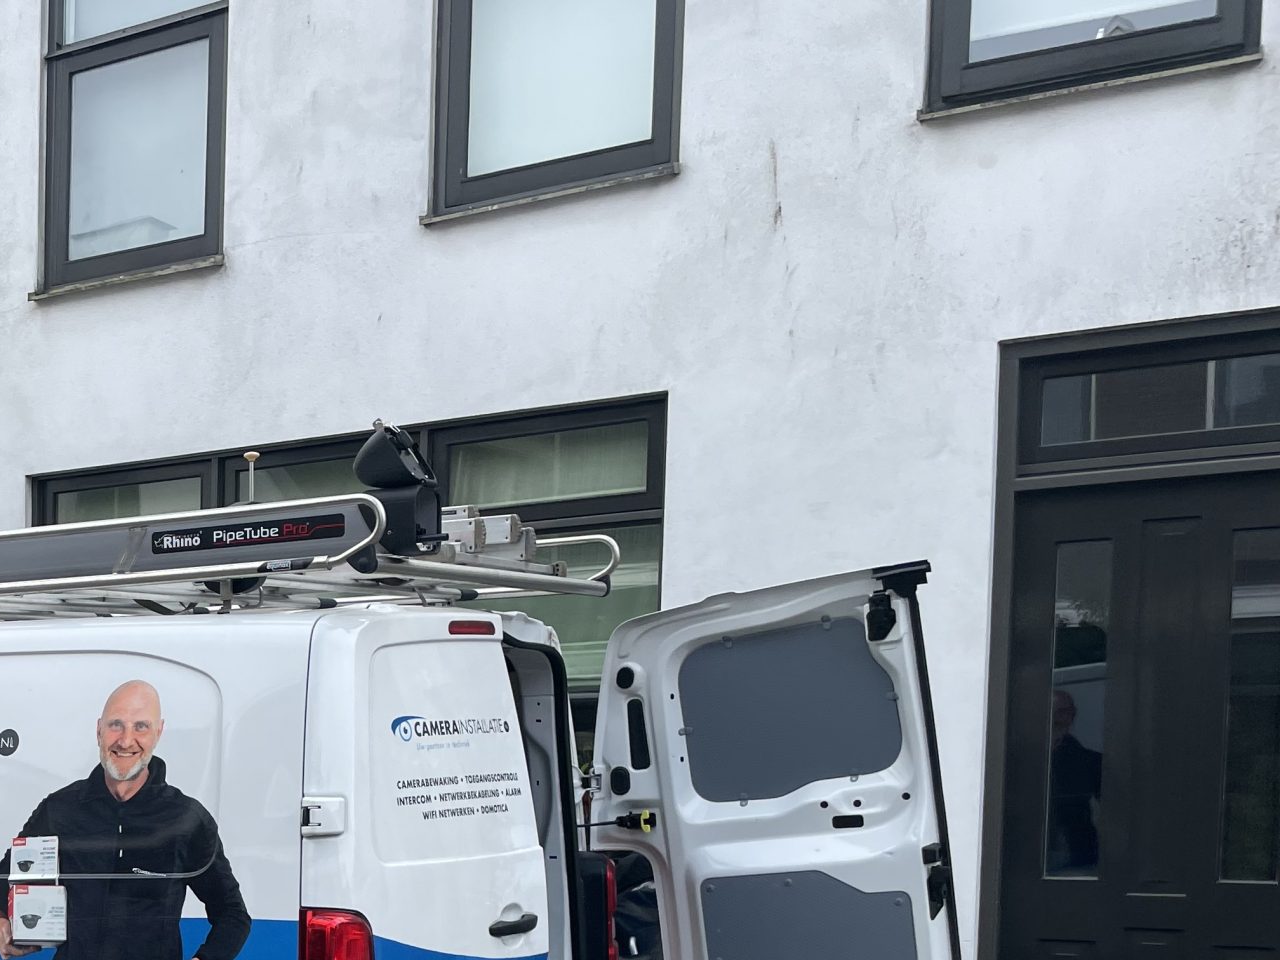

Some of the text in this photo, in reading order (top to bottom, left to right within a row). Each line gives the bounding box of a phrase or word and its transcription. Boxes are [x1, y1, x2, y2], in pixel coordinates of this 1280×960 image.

[163, 523, 308, 549] Rhino PipeTube Pro
[414, 719, 504, 737] CAMERAINSTALLATIE
[396, 776, 459, 790] CAMERABEWAKING
[396, 787, 522, 806] INTERCOM NETWERKBEKABELING ALARM
[422, 804, 509, 820] WIFI NETWERKEN DOMOTICA
